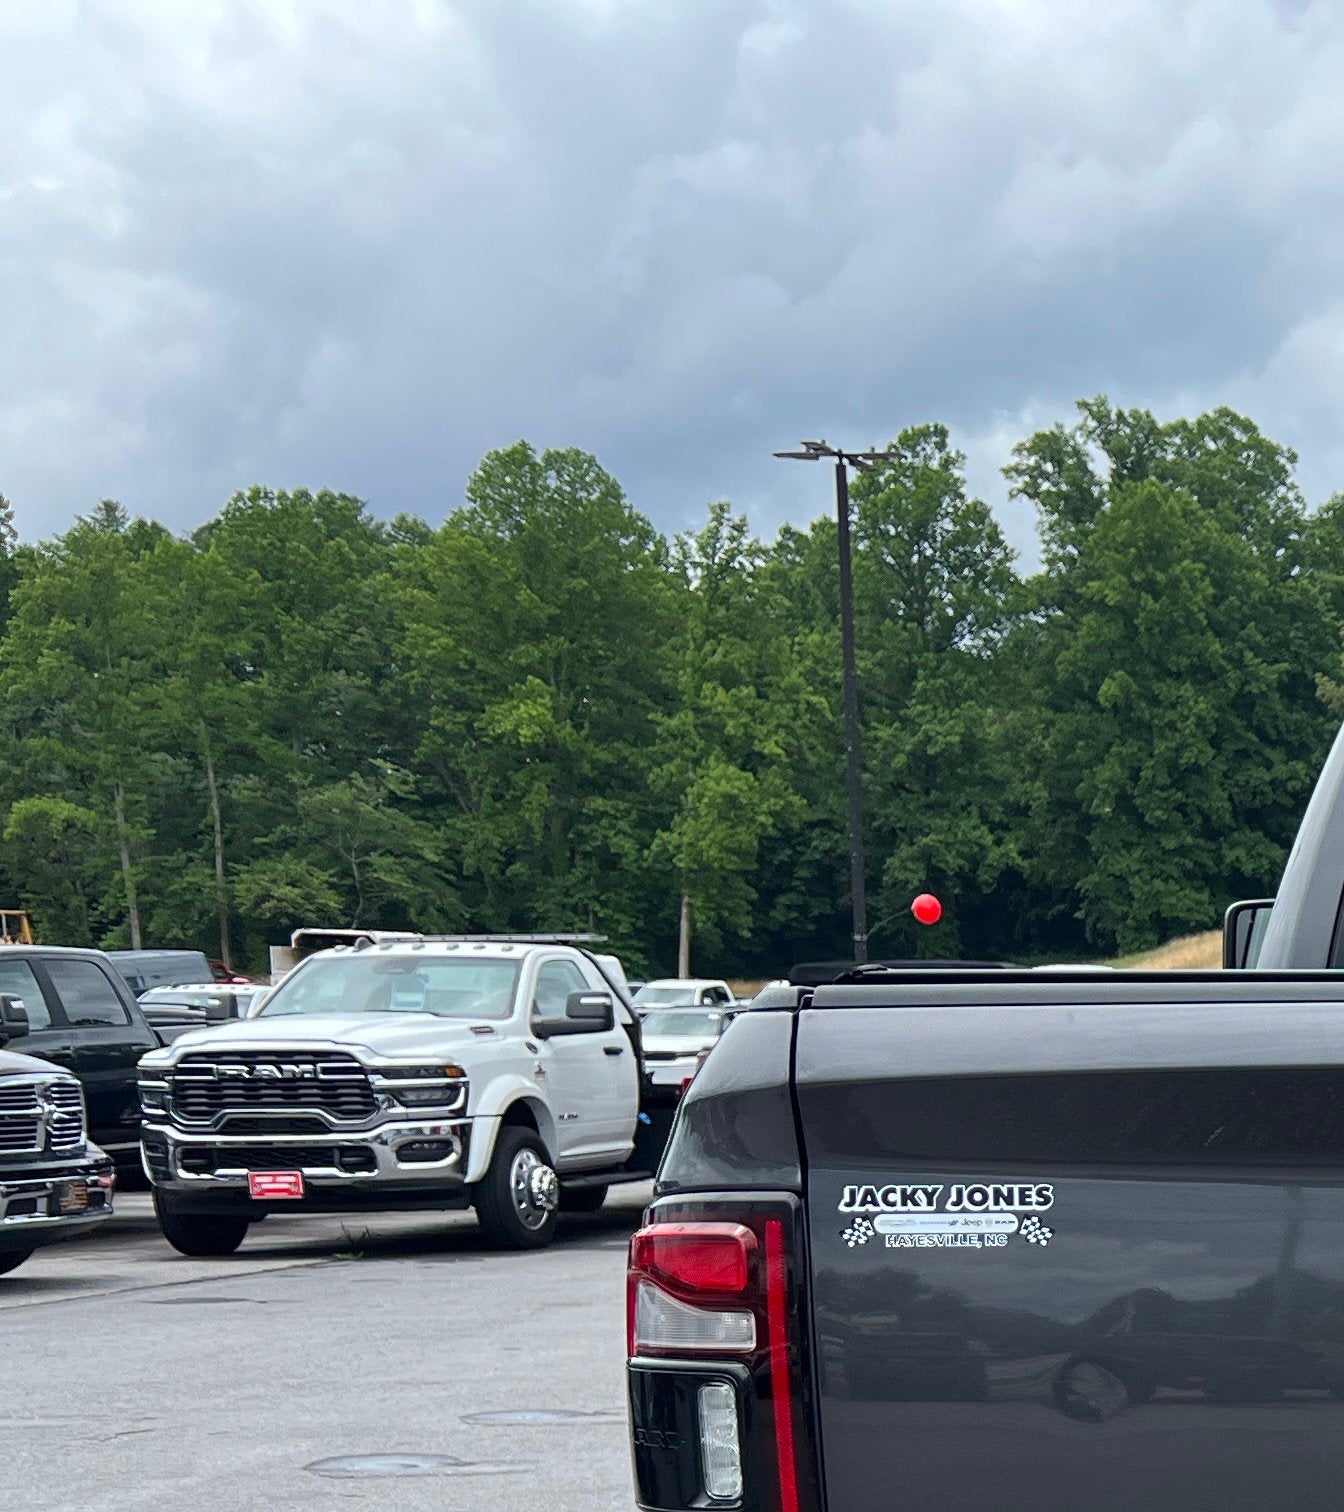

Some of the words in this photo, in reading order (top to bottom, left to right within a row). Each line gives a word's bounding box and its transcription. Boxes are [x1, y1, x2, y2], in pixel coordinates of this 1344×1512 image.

[217, 1064, 315, 1078] RAM
[839, 1184, 943, 1212] JACKY
[945, 1184, 1054, 1211] JONES
[885, 1233, 983, 1248] HAYESVILLE,
[984, 1233, 1008, 1247] NC
